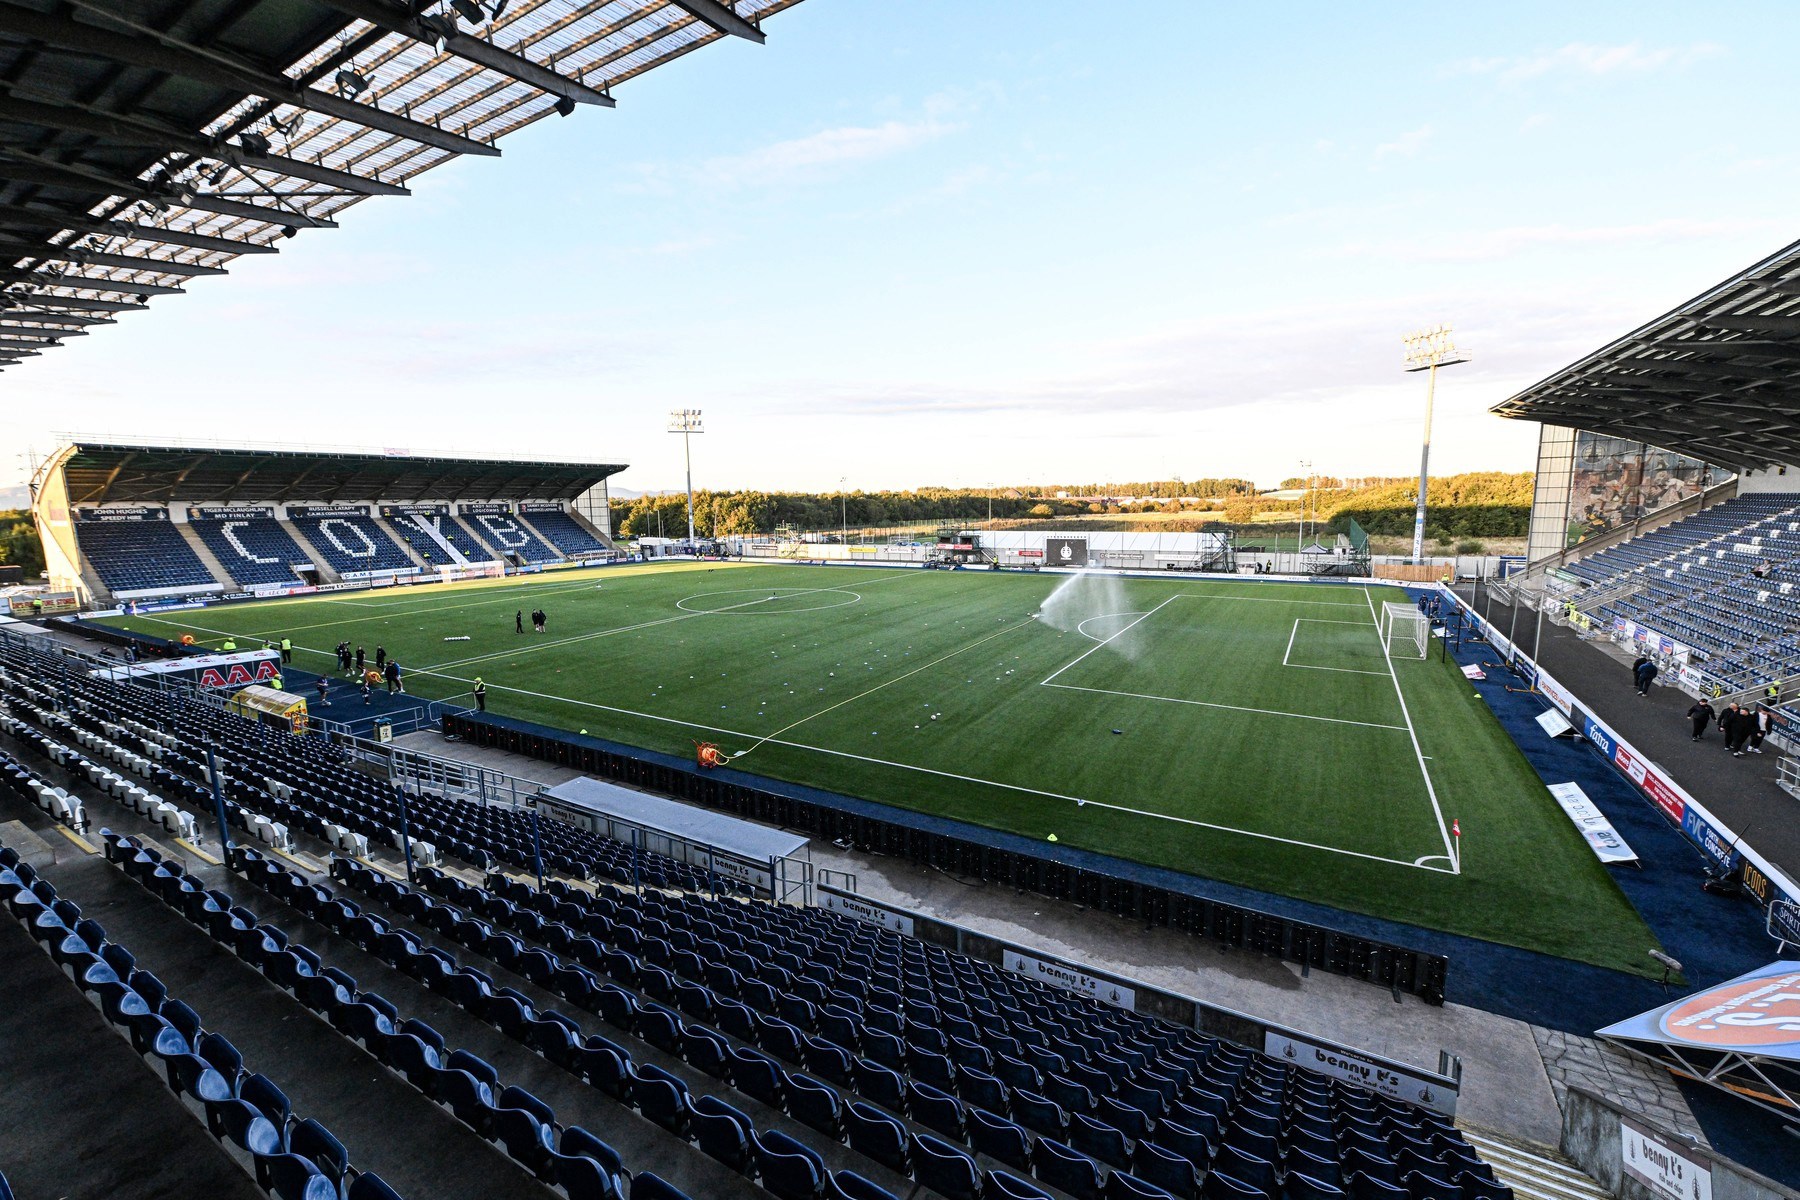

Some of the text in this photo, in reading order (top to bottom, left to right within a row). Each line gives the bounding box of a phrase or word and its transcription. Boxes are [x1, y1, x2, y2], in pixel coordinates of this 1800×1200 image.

[1686, 811, 1706, 843] FVC
[714, 857, 738, 873] benny
[843, 899, 886, 920] benny t's
[1038, 962, 1096, 990] benny t's
[1315, 1048, 1399, 1086] benny t's
[1348, 1073, 1362, 1084] fish
[1363, 1078, 1378, 1088] and
[1379, 1083, 1399, 1096] chips
[1642, 1138, 1683, 1180] benny t's
[1674, 1183, 1684, 1196] chips
